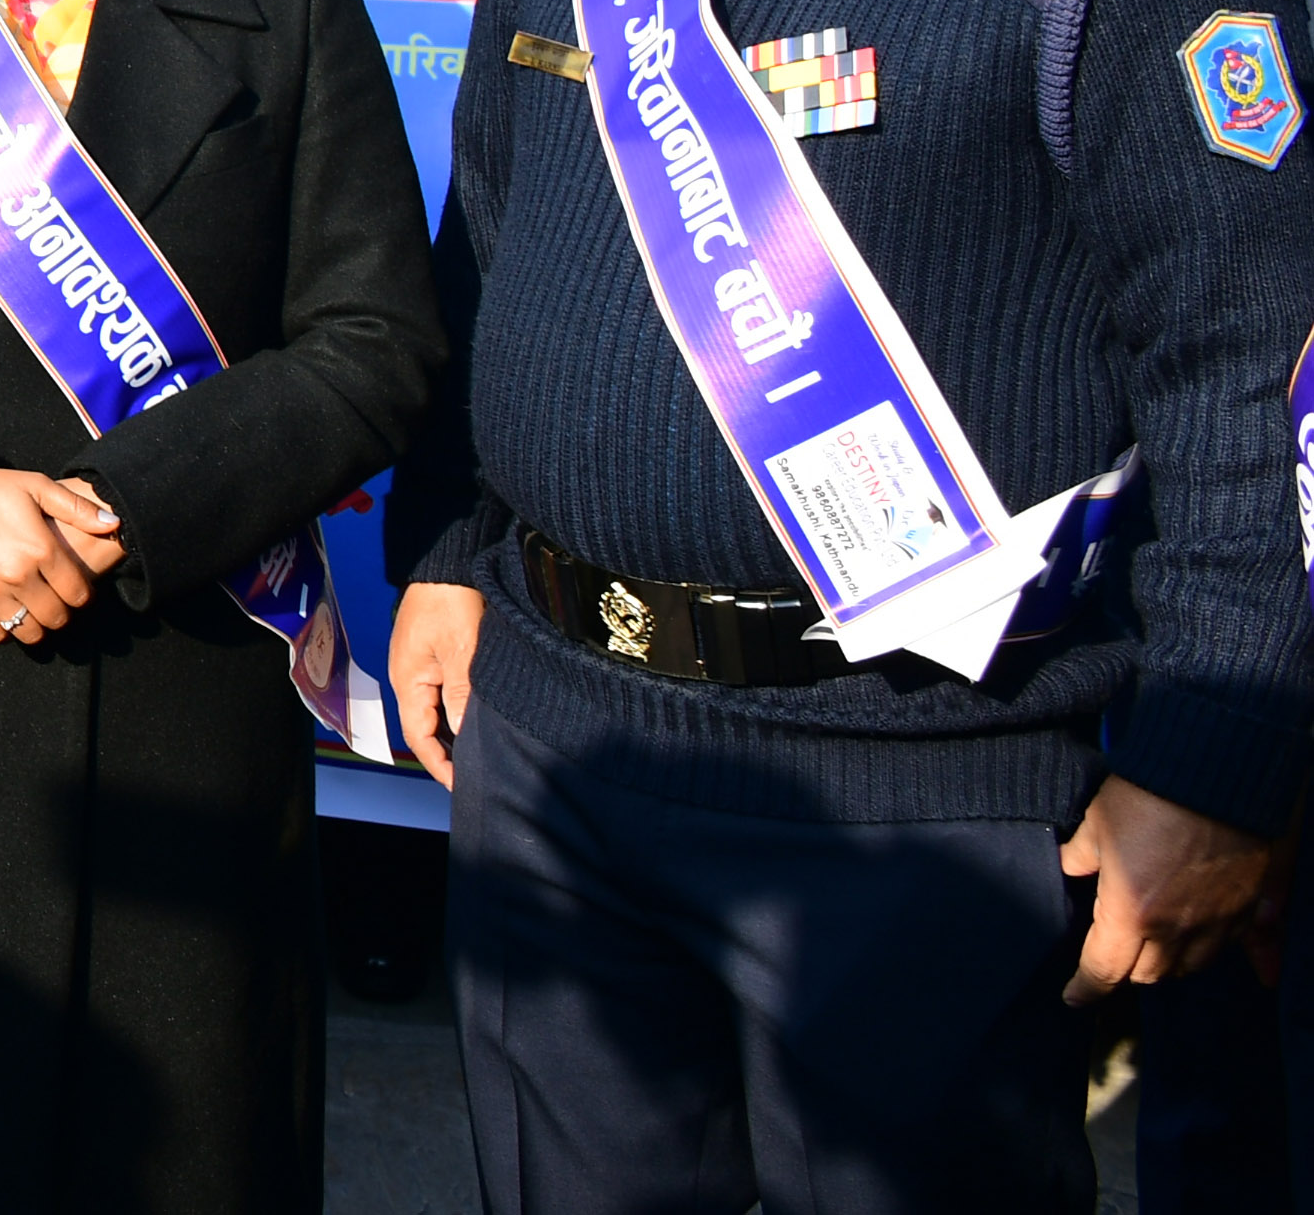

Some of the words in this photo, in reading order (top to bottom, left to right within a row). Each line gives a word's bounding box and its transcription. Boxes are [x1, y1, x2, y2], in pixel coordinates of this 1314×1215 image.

[0, 180, 174, 389] अनावश्यक
[836, 430, 892, 504] DESTINY
[818, 532, 860, 598] Kathmandu
